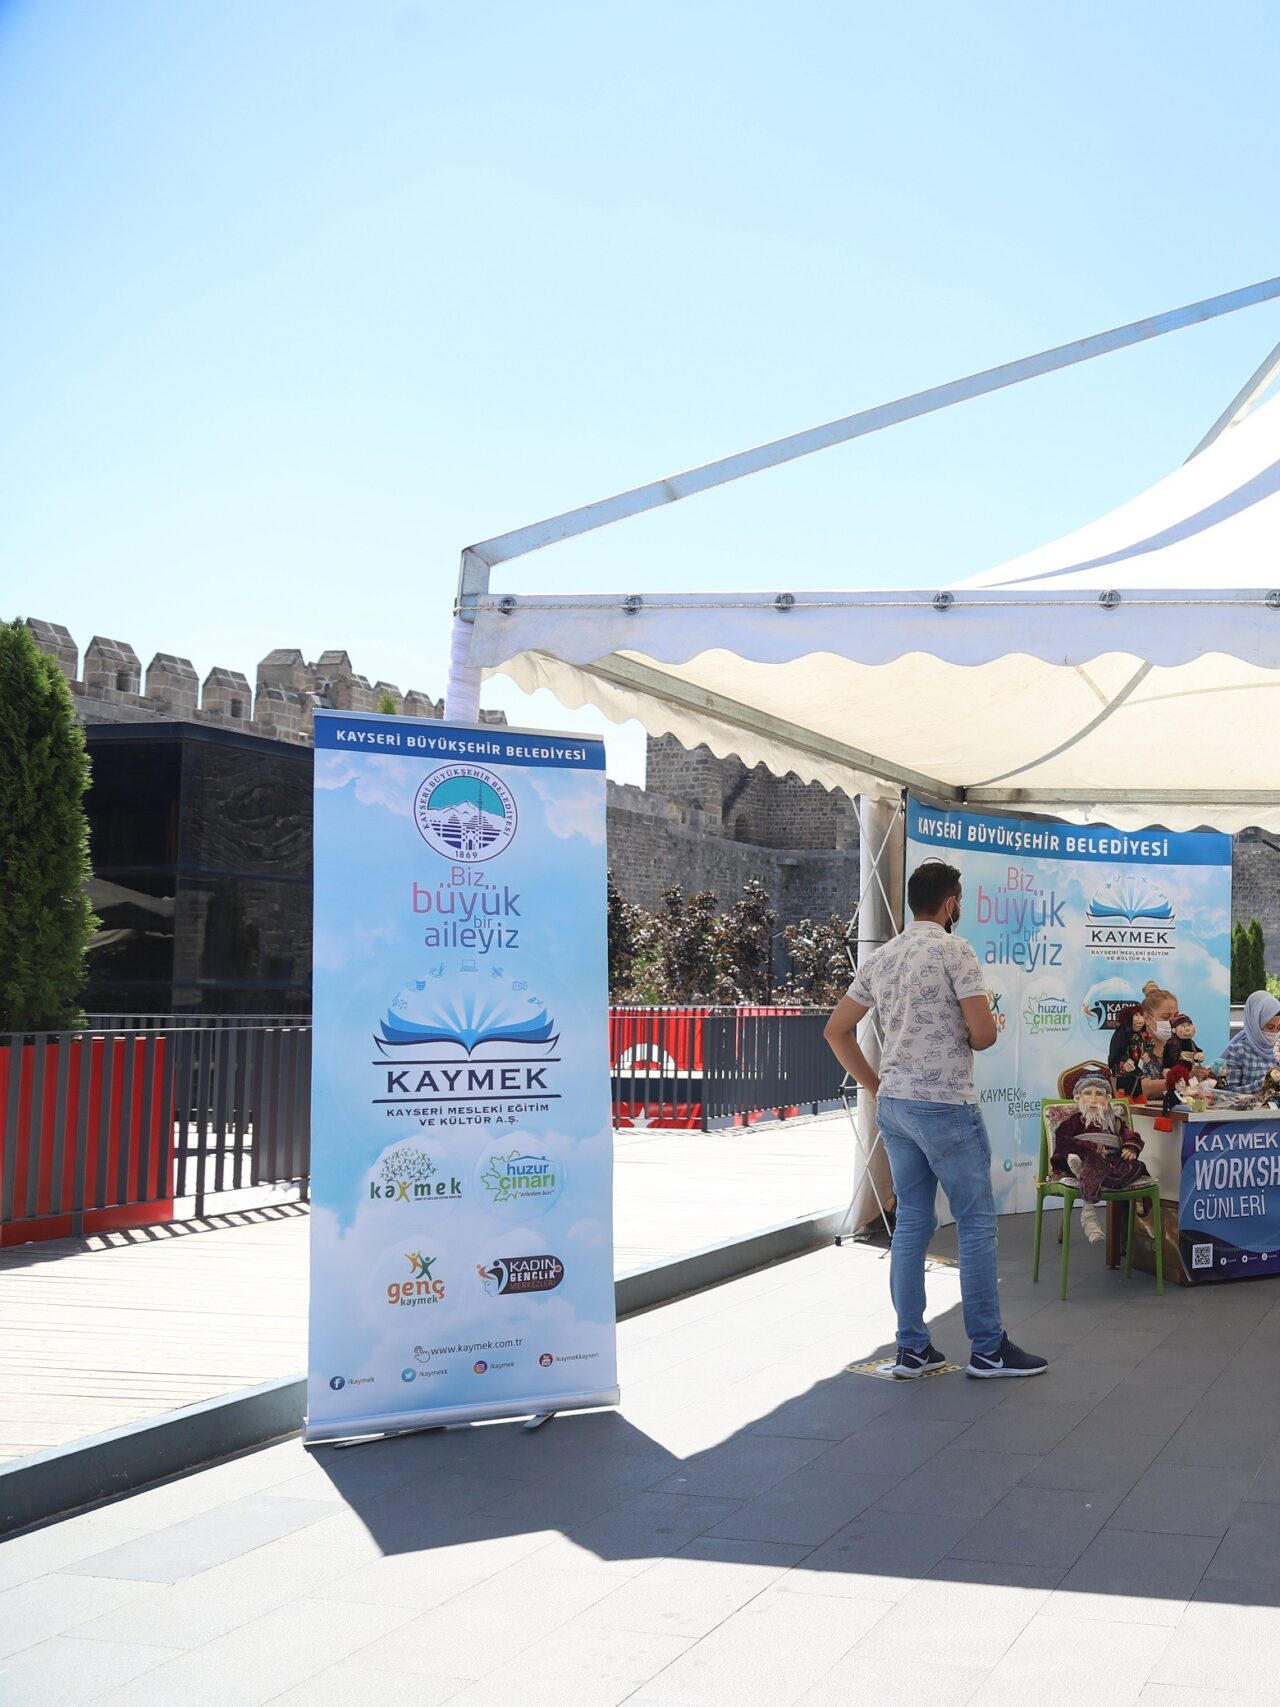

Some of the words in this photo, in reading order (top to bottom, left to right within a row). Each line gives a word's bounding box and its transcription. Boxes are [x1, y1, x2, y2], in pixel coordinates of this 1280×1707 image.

[336, 729, 401, 747] KAYSERİ
[407, 735, 501, 756] BÜYÜKŞEHİR
[506, 745, 587, 761] BELEDİYESİ
[918, 816, 962, 841] KAYSERİ
[967, 827, 1060, 851] BÜYÜKŞEHİR
[1066, 836, 1169, 857] BELEDİYESİ
[455, 850, 478, 859] 1869
[451, 866, 485, 888] Biz
[1007, 866, 1034, 892] Biz
[412, 881, 522, 922] büyük
[977, 885, 1066, 934] büyük
[473, 914, 493, 929] bir
[424, 921, 520, 954] aileyiz
[1023, 927, 1040, 943] bir
[1091, 930, 1169, 944] KAYMEK
[985, 934, 1062, 973] aileyiz
[1037, 1003, 1068, 1014] huzur
[1033, 1013, 1072, 1029] çınarı
[386, 1067, 549, 1093] KAYMEK
[980, 1087, 1021, 1103] KAYMEK
[386, 1106, 443, 1117] KAYSERİ
[448, 1104, 503, 1116] MESLEKİ
[507, 1102, 549, 1113] EĞİTİM
[419, 1118, 437, 1127] VE
[440, 1115, 492, 1126] KÜLTÜR
[495, 1115, 520, 1126] A.Ş.
[1194, 1131, 1279, 1151] KAYMEK
[506, 1163, 550, 1176] huzur
[370, 1177, 462, 1203] kaymek
[500, 1174, 556, 1195] çınarı
[1193, 1189, 1266, 1221] GÜNLERİ
[510, 1258, 556, 1272] KADIN
[387, 1279, 446, 1305] genç
[400, 1295, 439, 1308] kaymek
[430, 1338, 523, 1356] www.kaymek.com.tr
